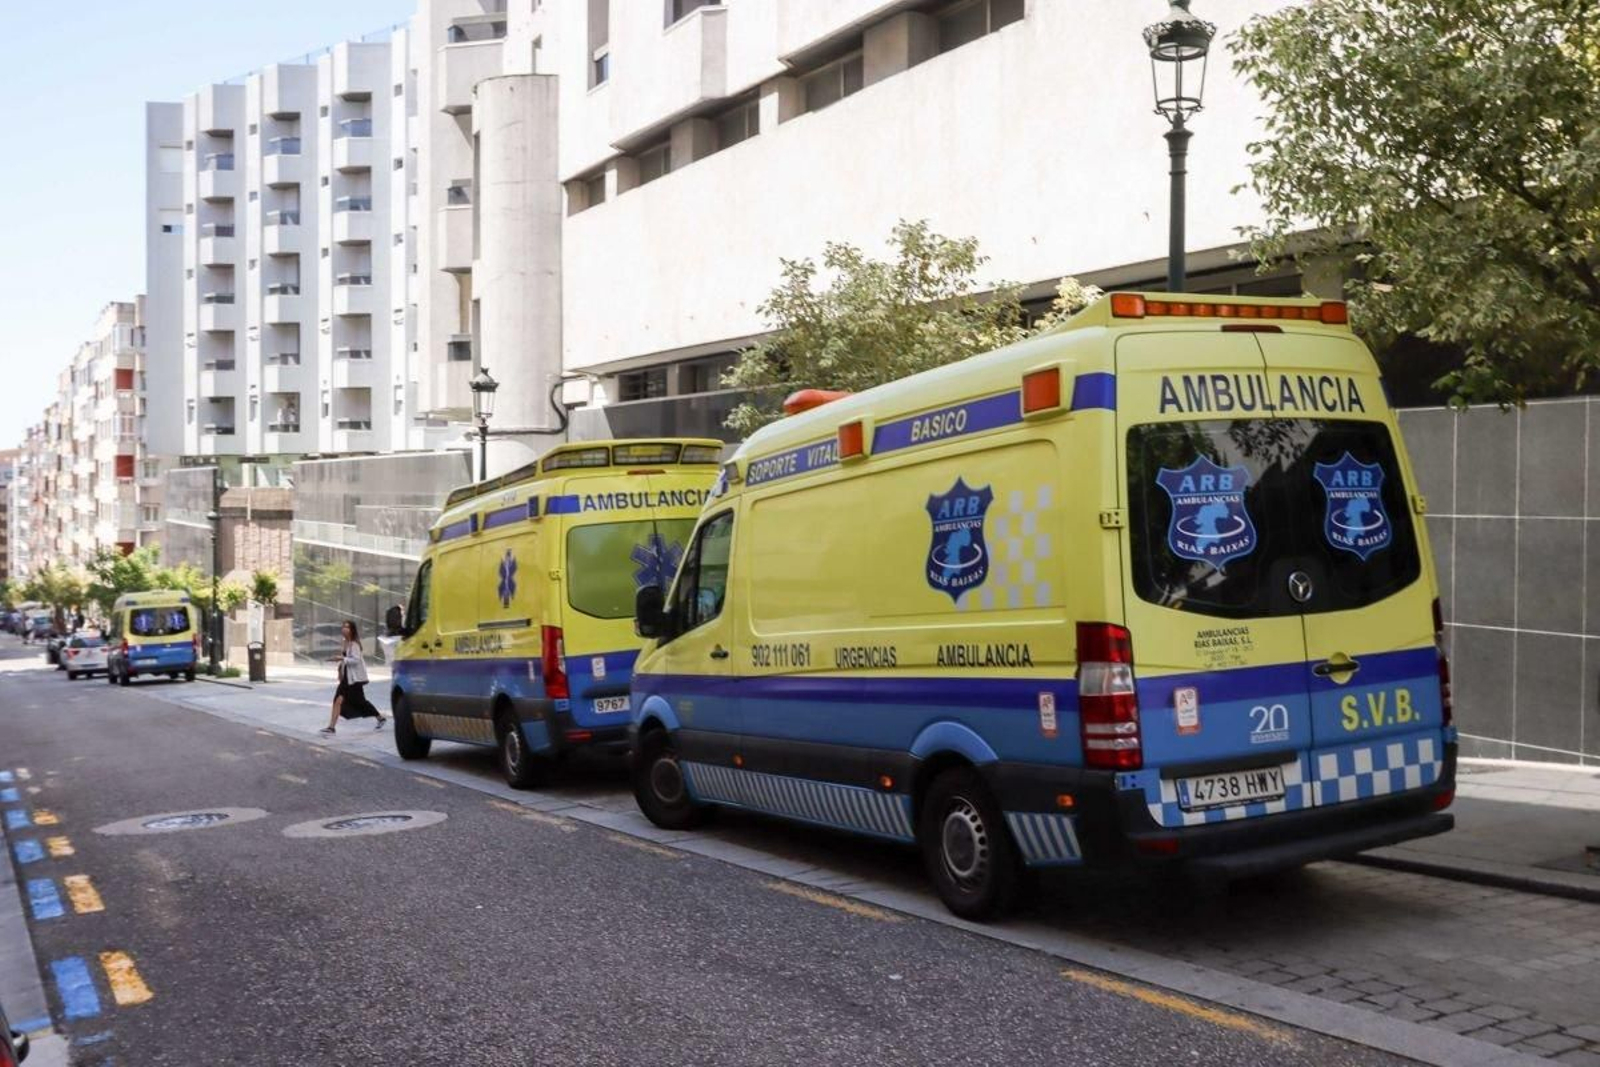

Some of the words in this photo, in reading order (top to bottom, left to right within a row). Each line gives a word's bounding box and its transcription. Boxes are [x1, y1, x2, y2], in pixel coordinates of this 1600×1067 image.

[1159, 374, 1365, 413] AMBULANCIA
[748, 453, 797, 483] SOPORTE
[807, 442, 839, 468] VITAL
[911, 409, 967, 441] BASICO
[1179, 474, 1234, 492] ARB
[1331, 470, 1373, 486] ARB
[938, 496, 980, 519] ARB
[1176, 495, 1240, 505] AMBULANCIAS
[935, 519, 981, 533] AMBULANCIAS
[1176, 540, 1204, 554] RIAS
[1210, 536, 1250, 555] BAIXAS
[1197, 626, 1249, 638] AMBULANCIAS
[752, 644, 770, 667] 902
[773, 644, 788, 667] 111
[791, 643, 811, 666] 061
[835, 646, 897, 668] URGENCIAS
[937, 644, 1033, 668] AMBULANCIA
[597, 698, 625, 711] 9767
[1341, 688, 1420, 731] S.V.B.
[1249, 704, 1289, 733] 20
[1194, 776, 1241, 801] 4738
[1245, 770, 1279, 795] HWY
